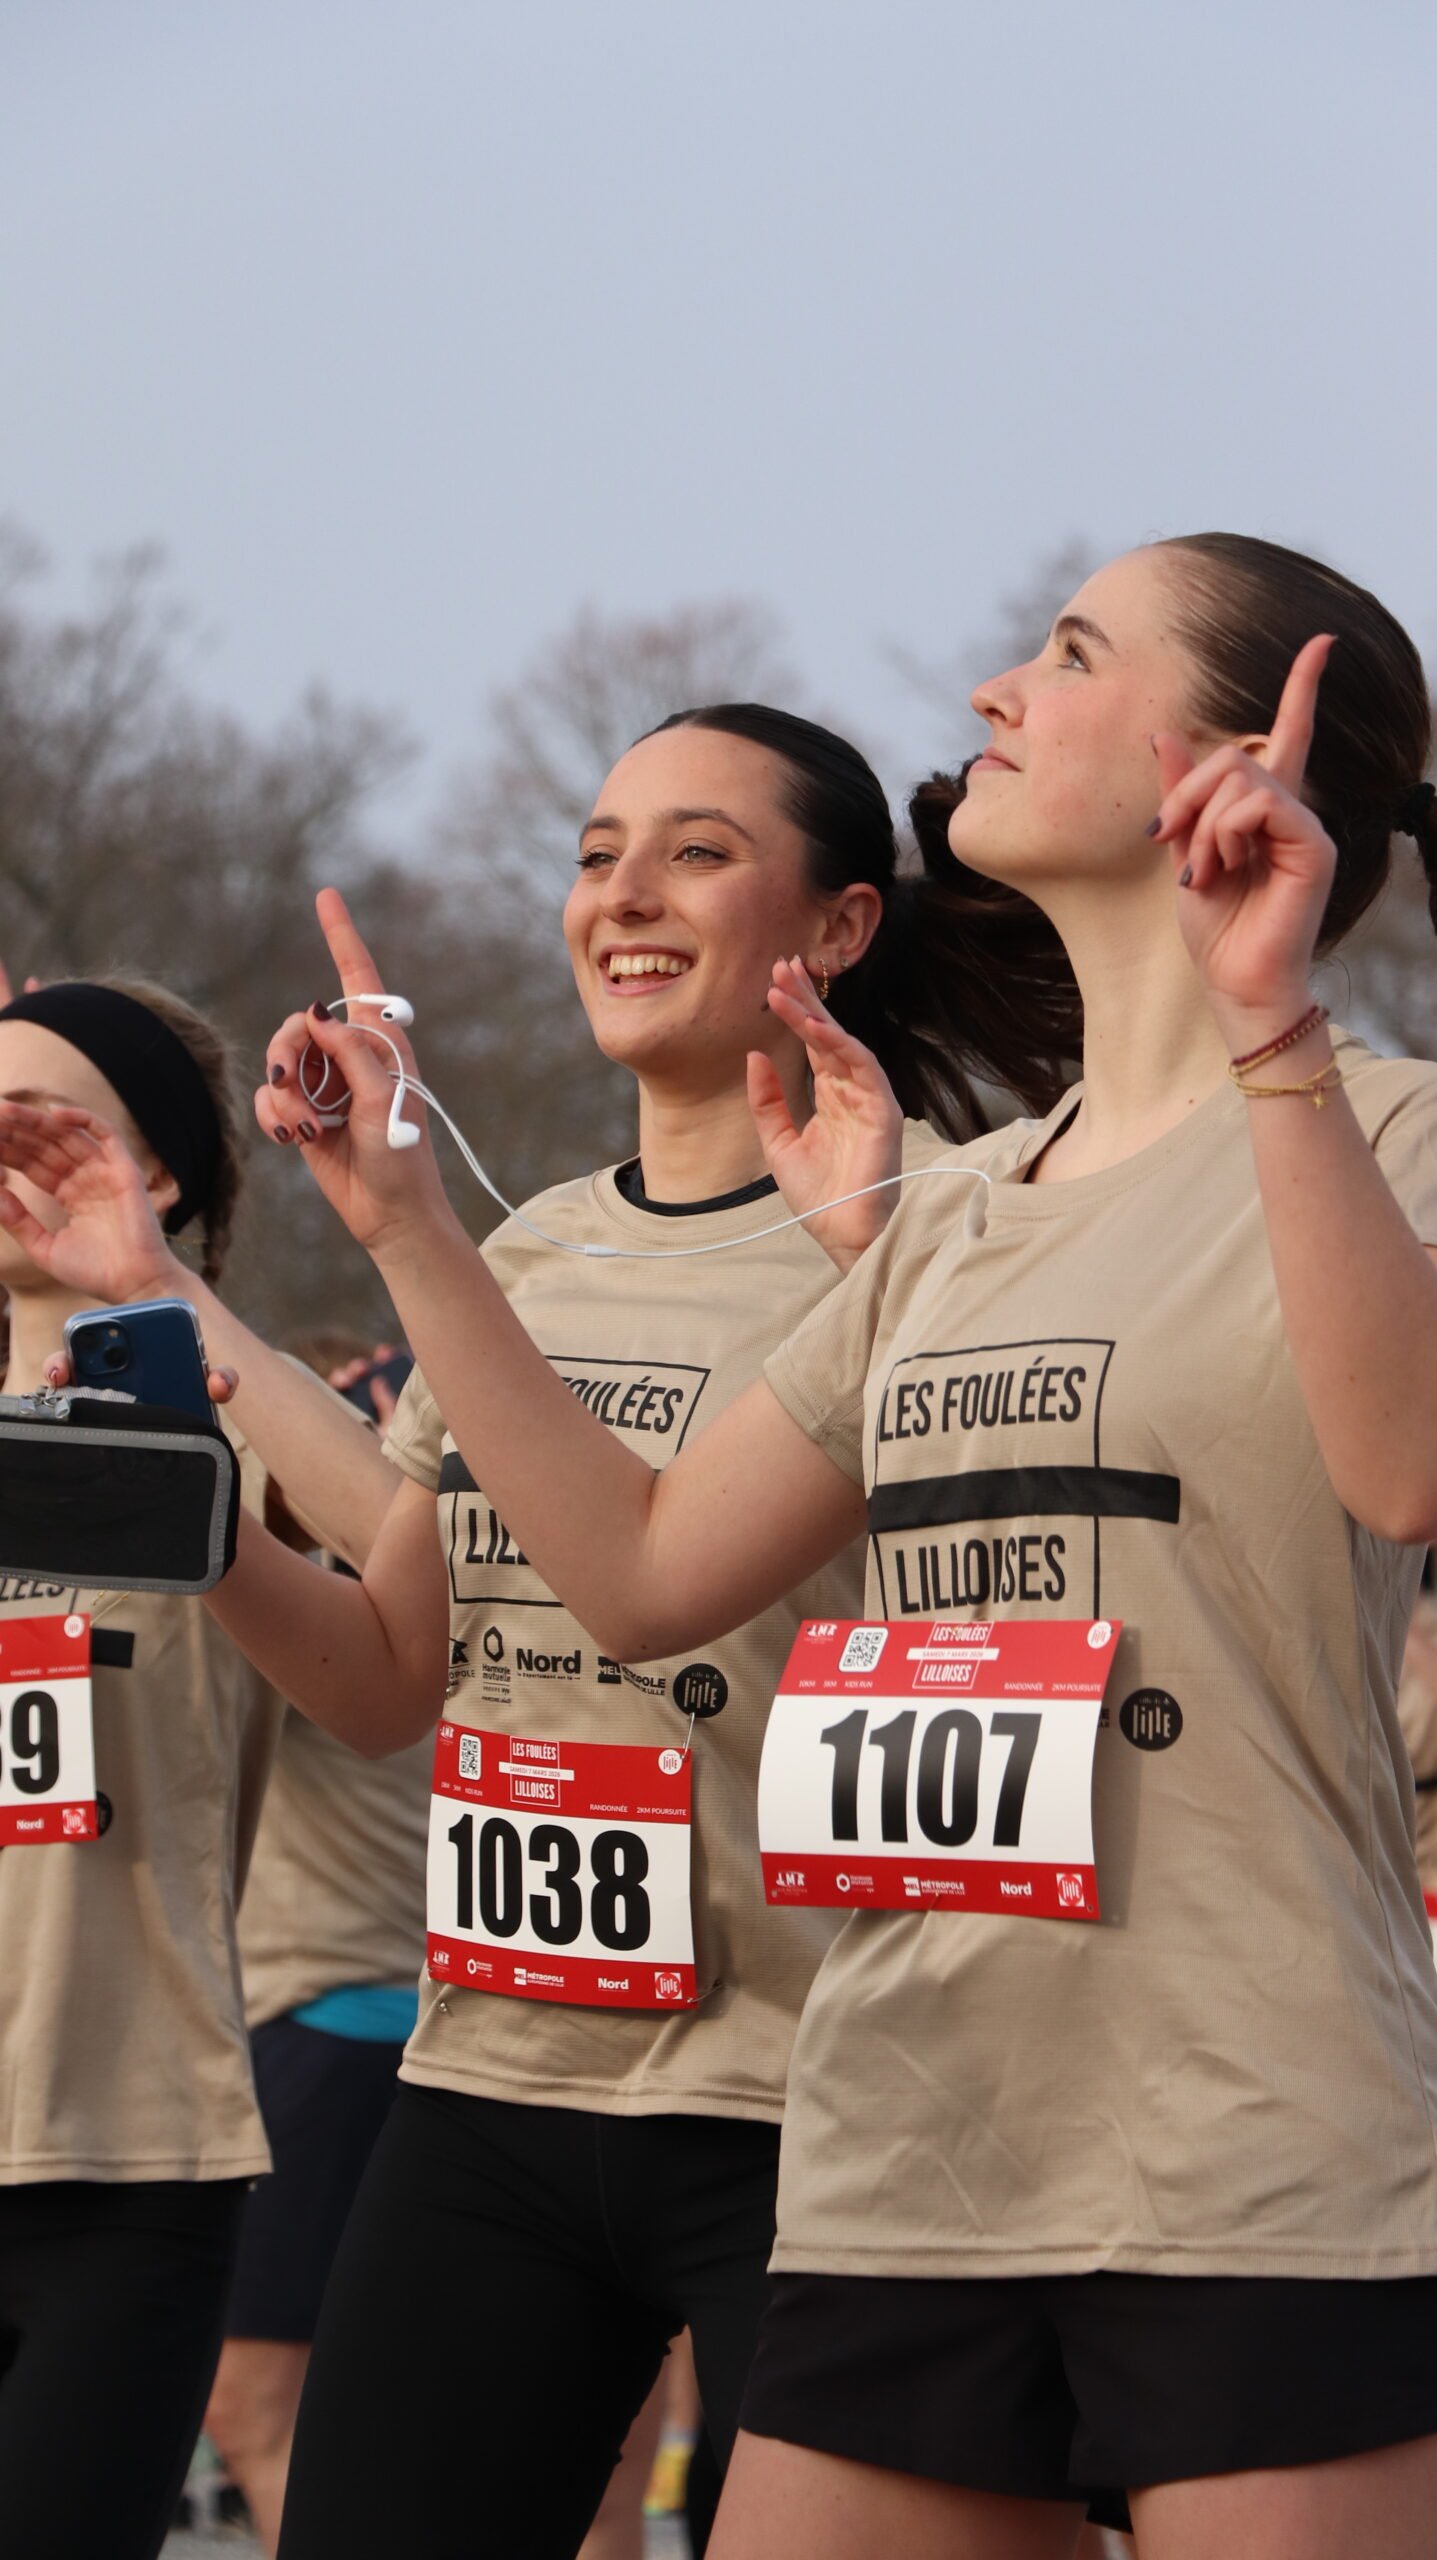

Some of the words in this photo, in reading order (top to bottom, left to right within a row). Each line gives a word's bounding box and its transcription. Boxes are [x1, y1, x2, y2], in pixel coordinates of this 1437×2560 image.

[561, 1376, 684, 1434] ULÉES
[878, 1380, 934, 1443] LES
[942, 1356, 1087, 1433] FOULÉES
[895, 1534, 1066, 1614] LILLOISES
[933, 1626, 950, 1642] LES
[516, 1648, 582, 1674] Nord
[921, 1664, 972, 1682] LILLOISES
[0, 1690, 60, 1795] 9
[512, 1742, 525, 1757] LES
[526, 1743, 556, 1760] FOULÉES
[819, 1708, 1043, 1848] 1107
[515, 1780, 555, 1800] LILLOISES
[589, 1804, 628, 1813] RANDONNÉE
[652, 1807, 687, 1816] POURSUITE
[16, 1818, 45, 1831] Nord
[448, 1813, 651, 1952] 1038
[921, 1879, 965, 1890] MÉTROPOLE
[1000, 1881, 1032, 1896] Nord
[527, 1971, 564, 1983] MÉTROPOLE
[598, 1978, 629, 1990] Nord
